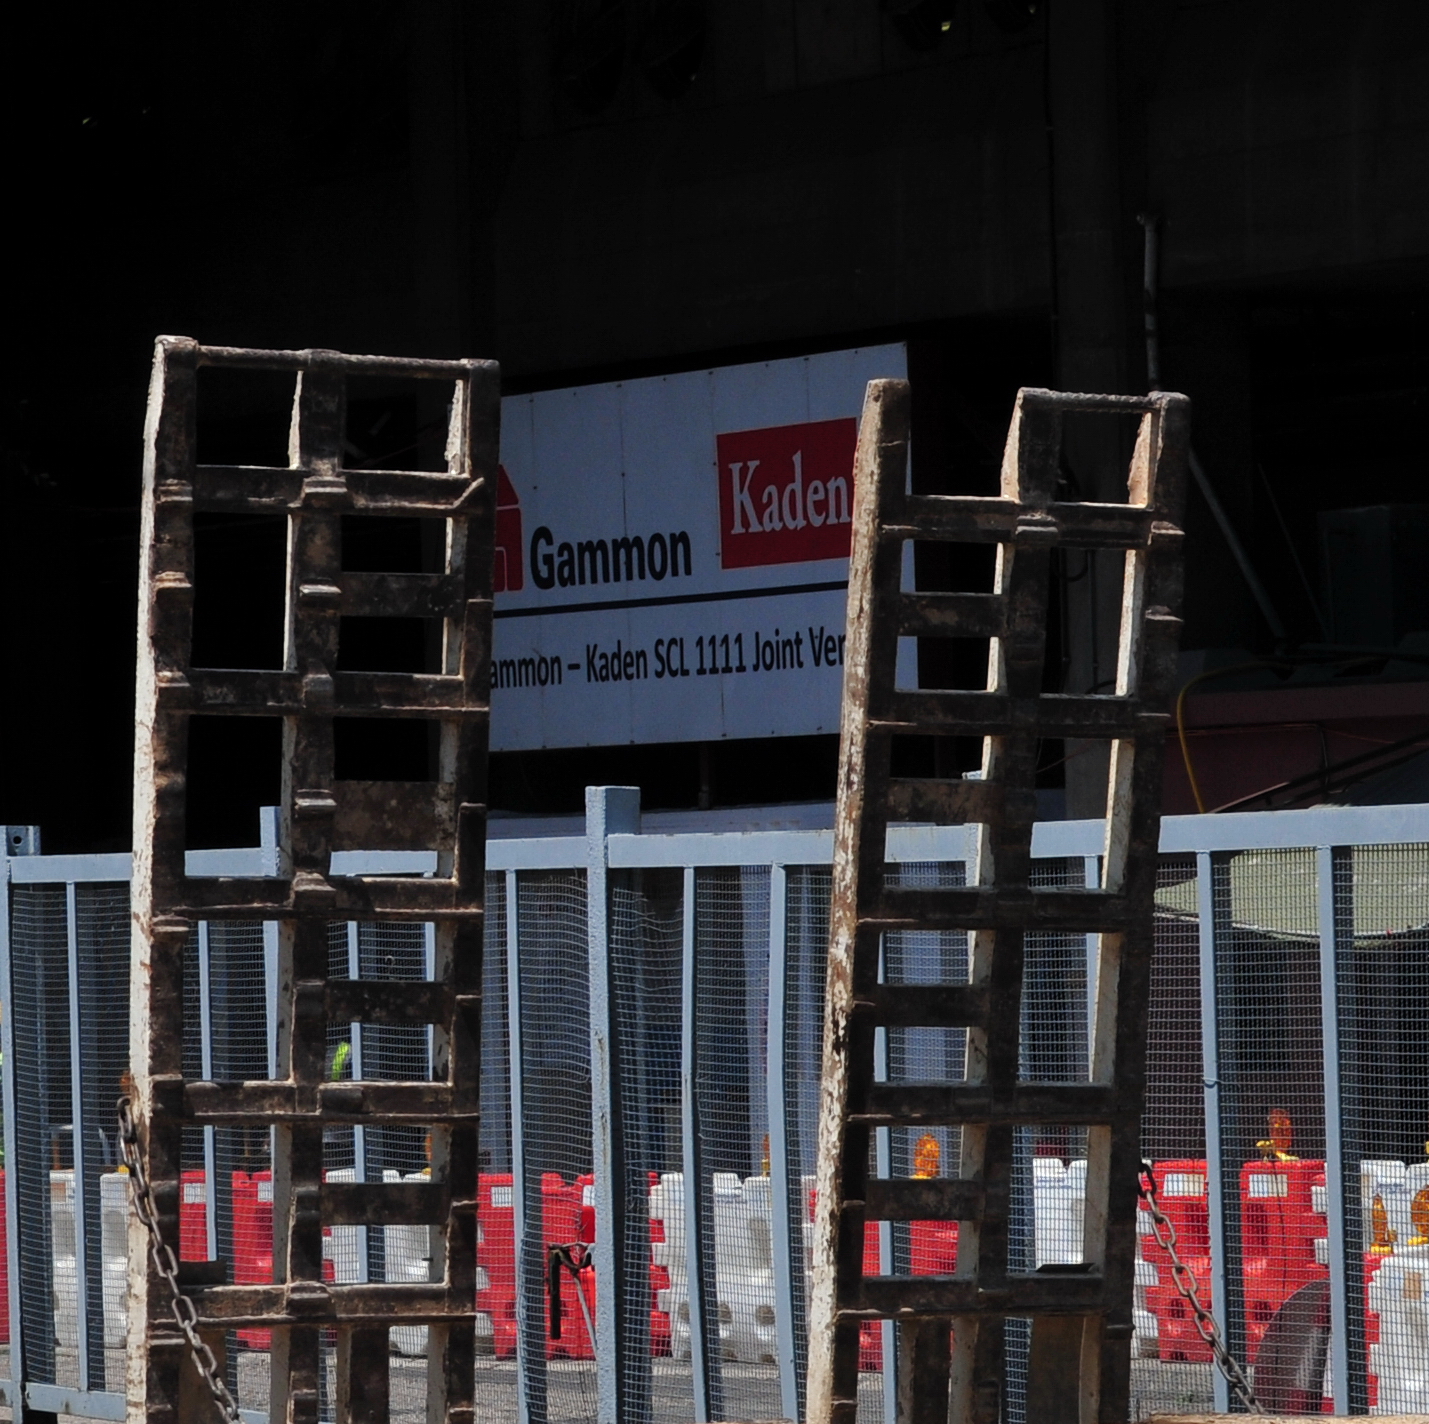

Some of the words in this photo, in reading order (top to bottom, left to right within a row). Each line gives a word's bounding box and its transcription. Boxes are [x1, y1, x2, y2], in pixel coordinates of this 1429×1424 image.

[728, 450, 853, 535] Kaden
[529, 525, 692, 590] Gammon
[490, 656, 562, 689] ammon
[586, 639, 648, 683] Kaden
[654, 637, 689, 679] SCL
[696, 633, 746, 676] 1111
[752, 628, 804, 672] Joint
